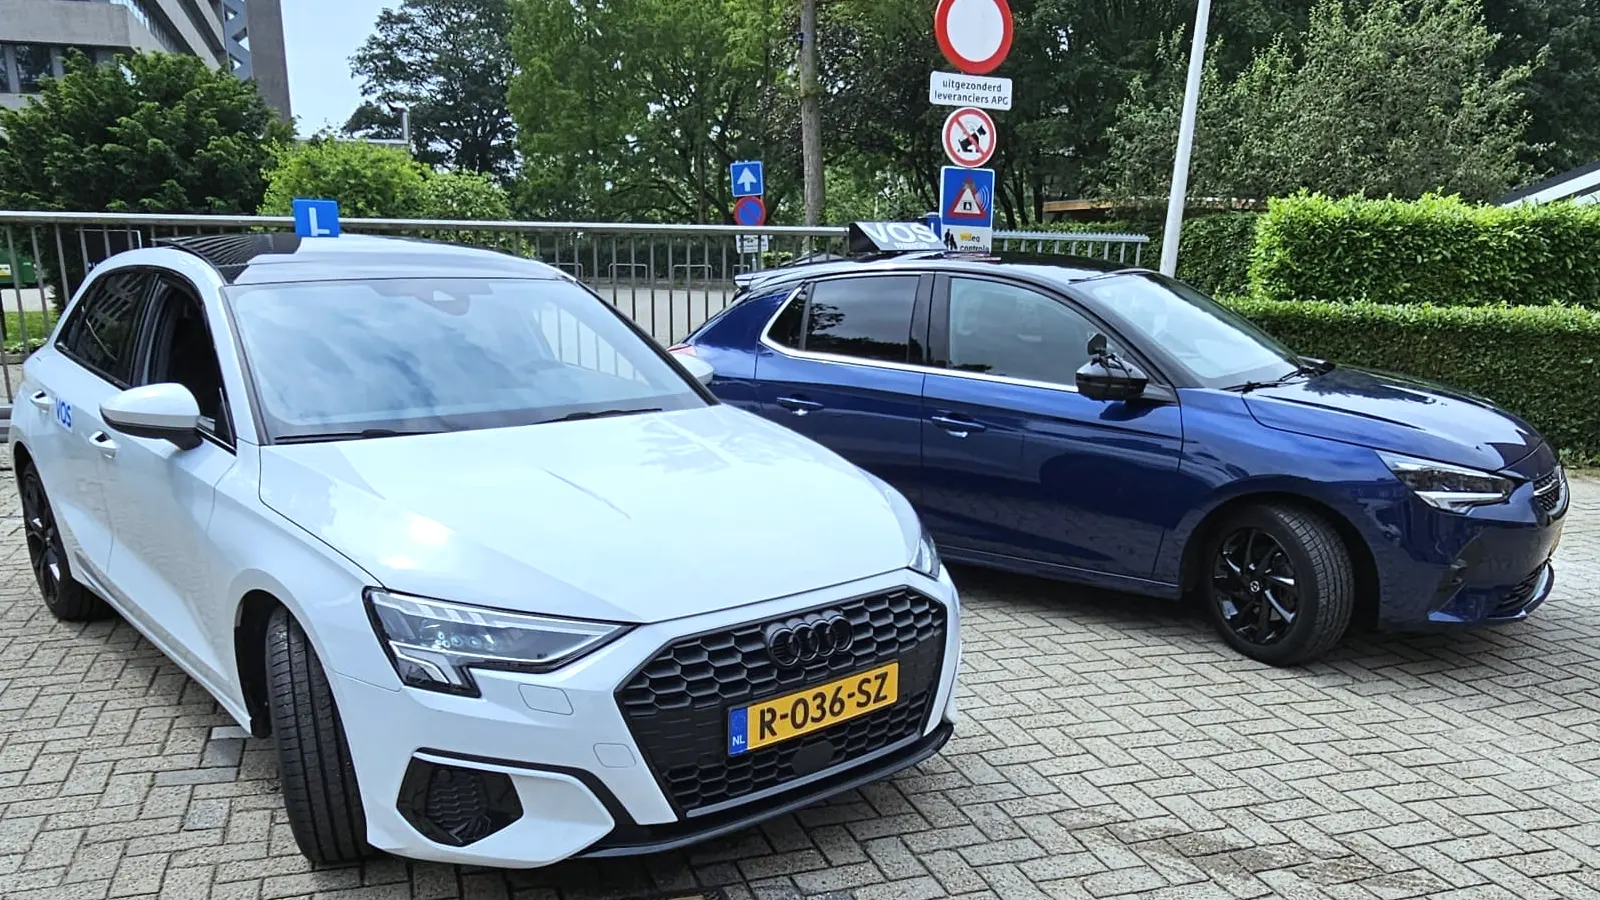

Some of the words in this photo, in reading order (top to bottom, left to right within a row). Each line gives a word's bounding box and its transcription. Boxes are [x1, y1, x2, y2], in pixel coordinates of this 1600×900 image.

[942, 79, 1002, 92] uitgezonderd
[934, 90, 989, 104] leveranciers
[991, 96, 1009, 105] APG
[308, 207, 330, 237] L
[858, 222, 939, 243] VOS
[56, 397, 72, 428] VOS
[759, 671, 889, 740] R-036-SZ
[732, 735, 746, 746] NL
